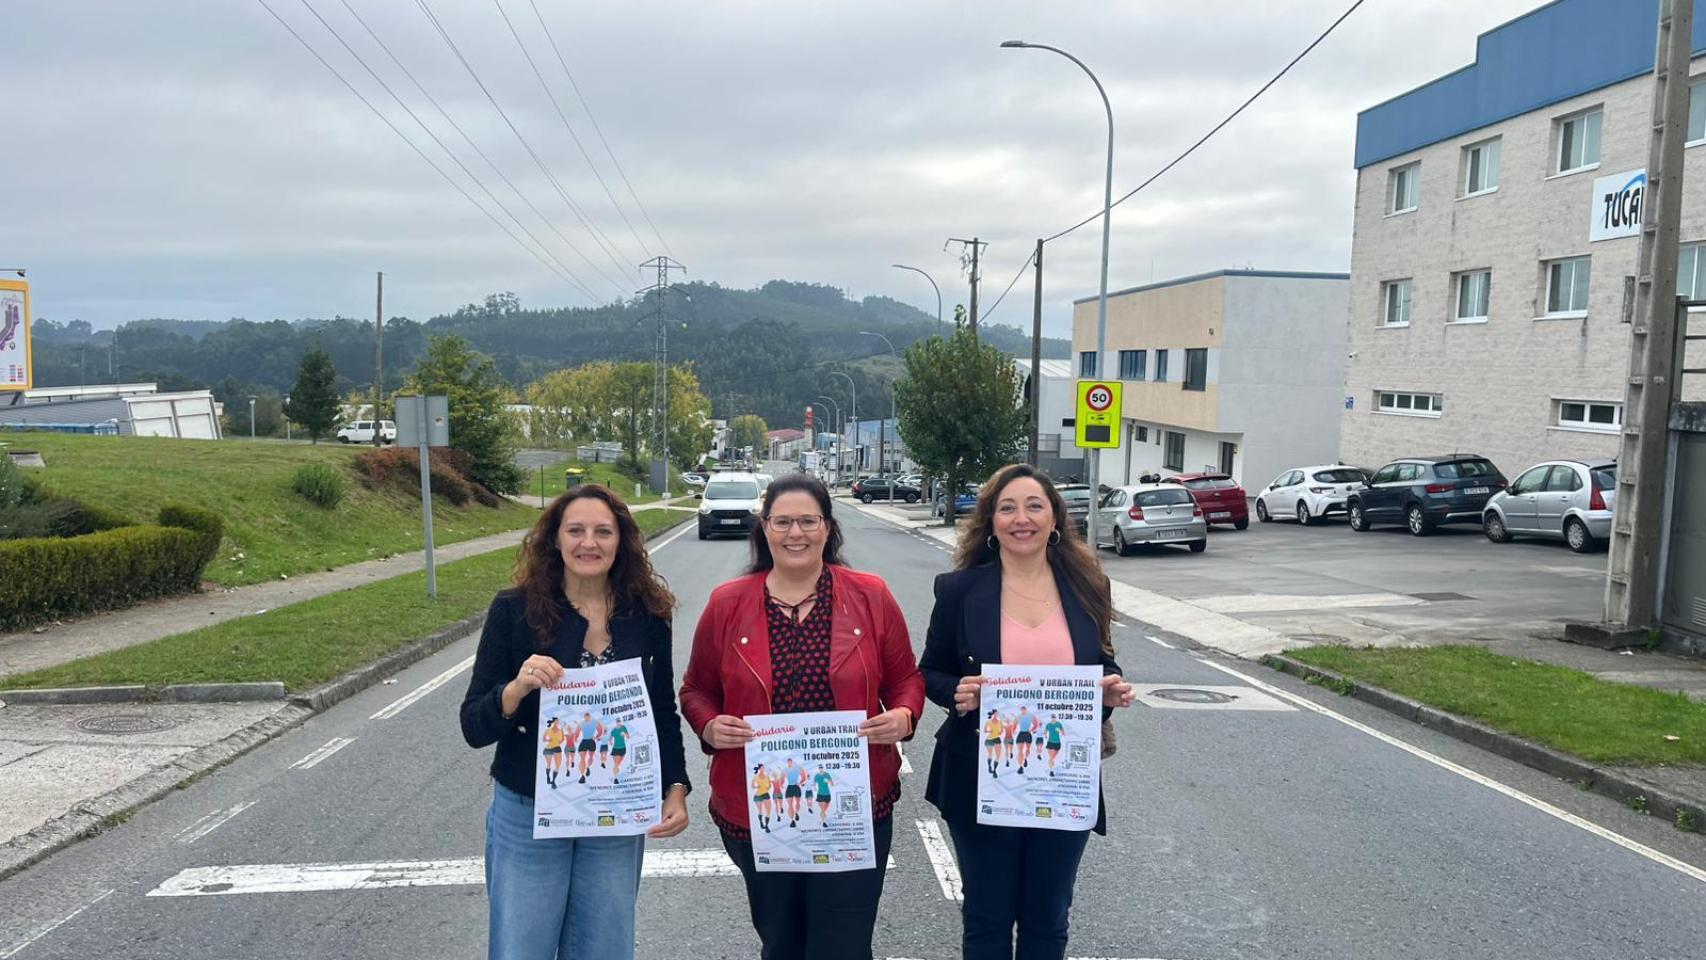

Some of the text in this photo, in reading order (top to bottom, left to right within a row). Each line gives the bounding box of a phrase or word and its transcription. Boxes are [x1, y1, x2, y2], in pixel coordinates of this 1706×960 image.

[1604, 187, 1644, 229] TUCA
[1091, 393, 1107, 403] 50
[1040, 679, 1095, 688] V URBAN TRAIL
[557, 685, 643, 706] POLÍGONO BERGONDO
[1044, 689, 1095, 701] BERGONDO
[602, 707, 609, 716] 11
[610, 703, 633, 716] octubre
[1037, 702, 1094, 711] 11 octubre 2025
[803, 727, 809, 736] V
[810, 725, 837, 735] URBAN
[809, 736, 860, 749] BERGONDO
[803, 750, 860, 760] 11 octubre 2025
